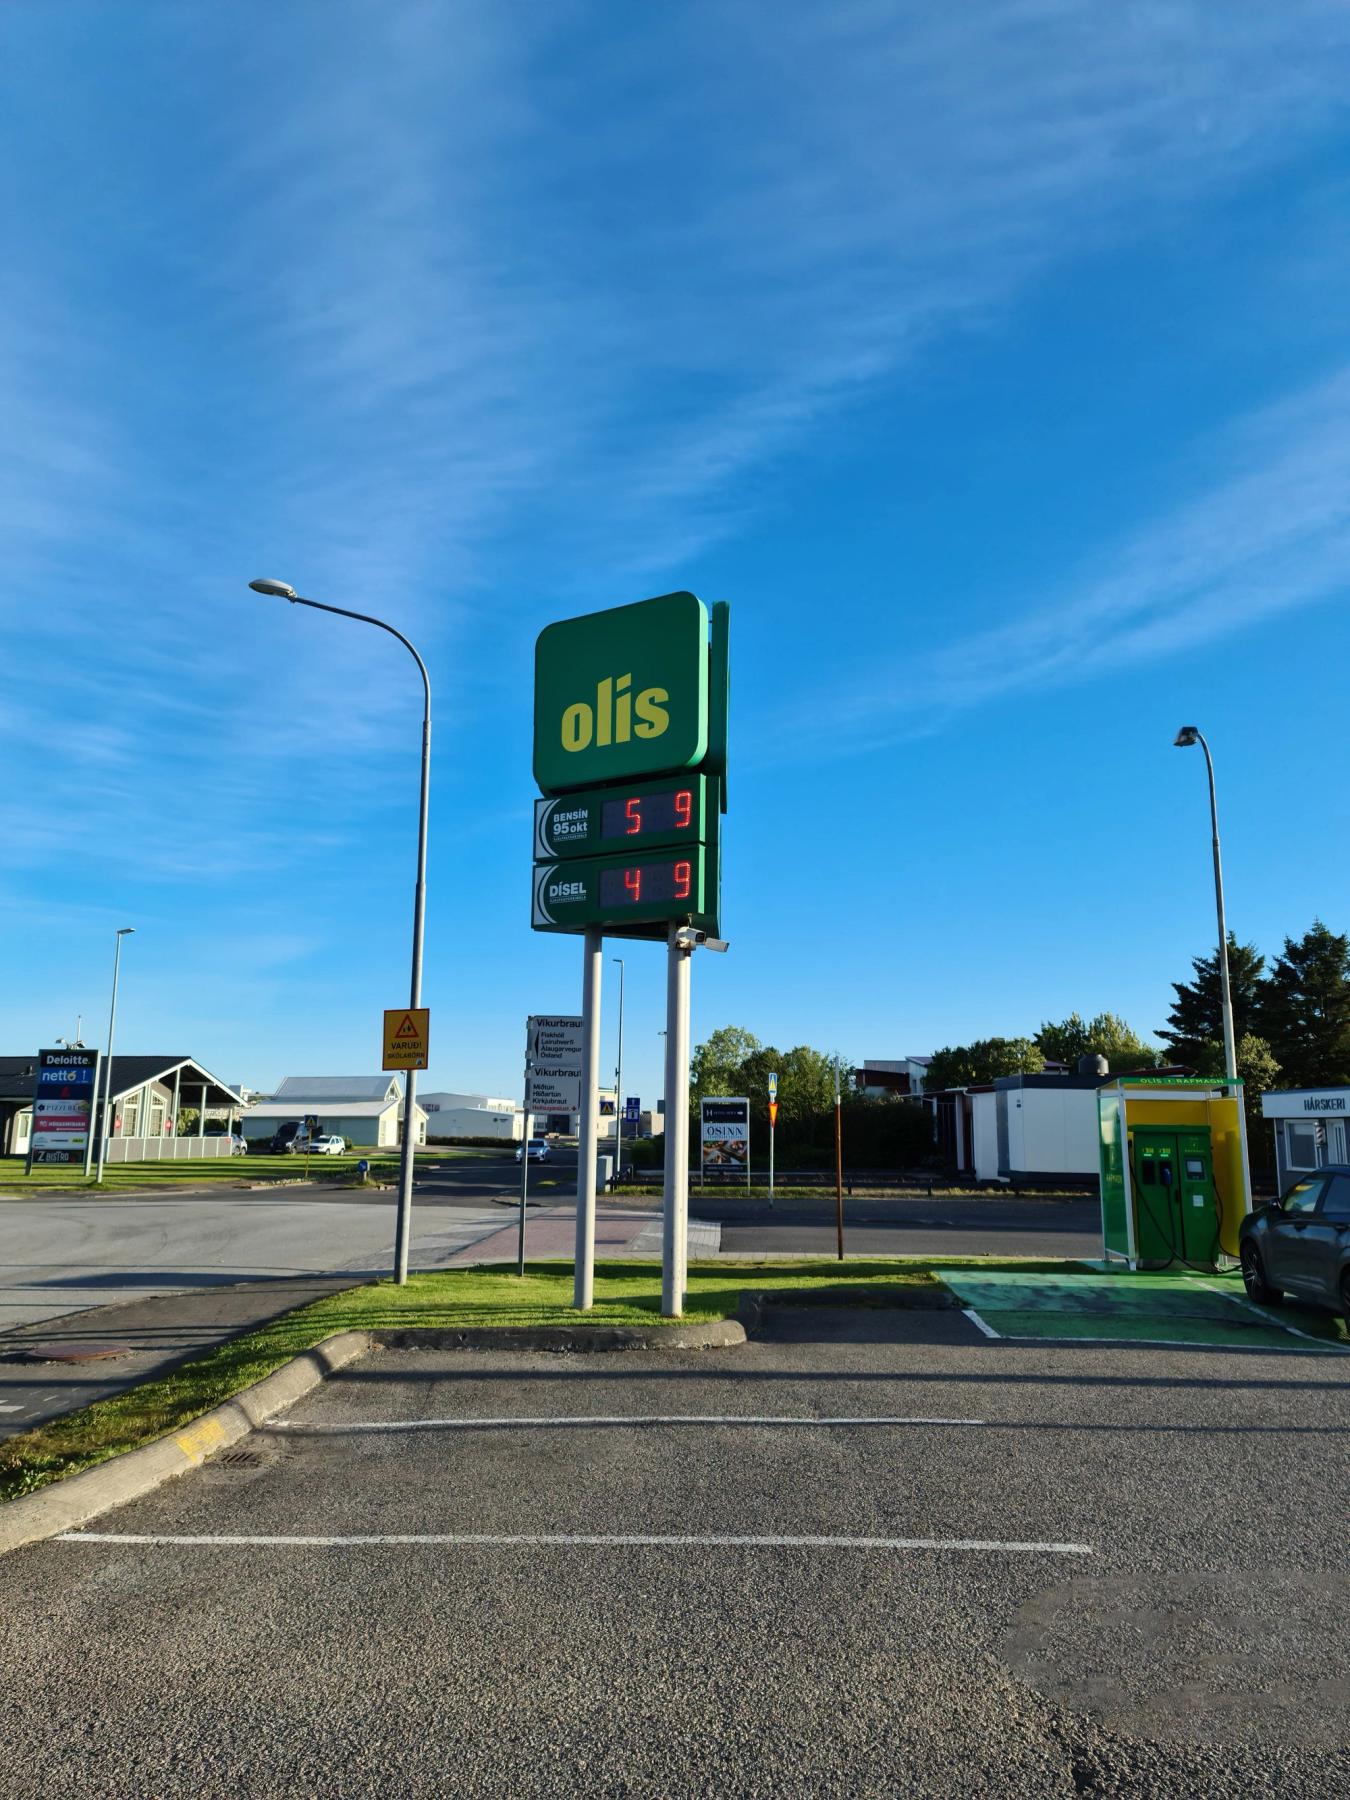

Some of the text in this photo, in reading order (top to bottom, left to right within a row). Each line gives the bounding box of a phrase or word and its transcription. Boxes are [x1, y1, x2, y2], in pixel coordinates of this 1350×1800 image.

[561, 672, 670, 752] olis
[553, 808, 589, 823] BENSÍN
[553, 821, 588, 836] 95 okt
[549, 881, 587, 898] DÍSEL
